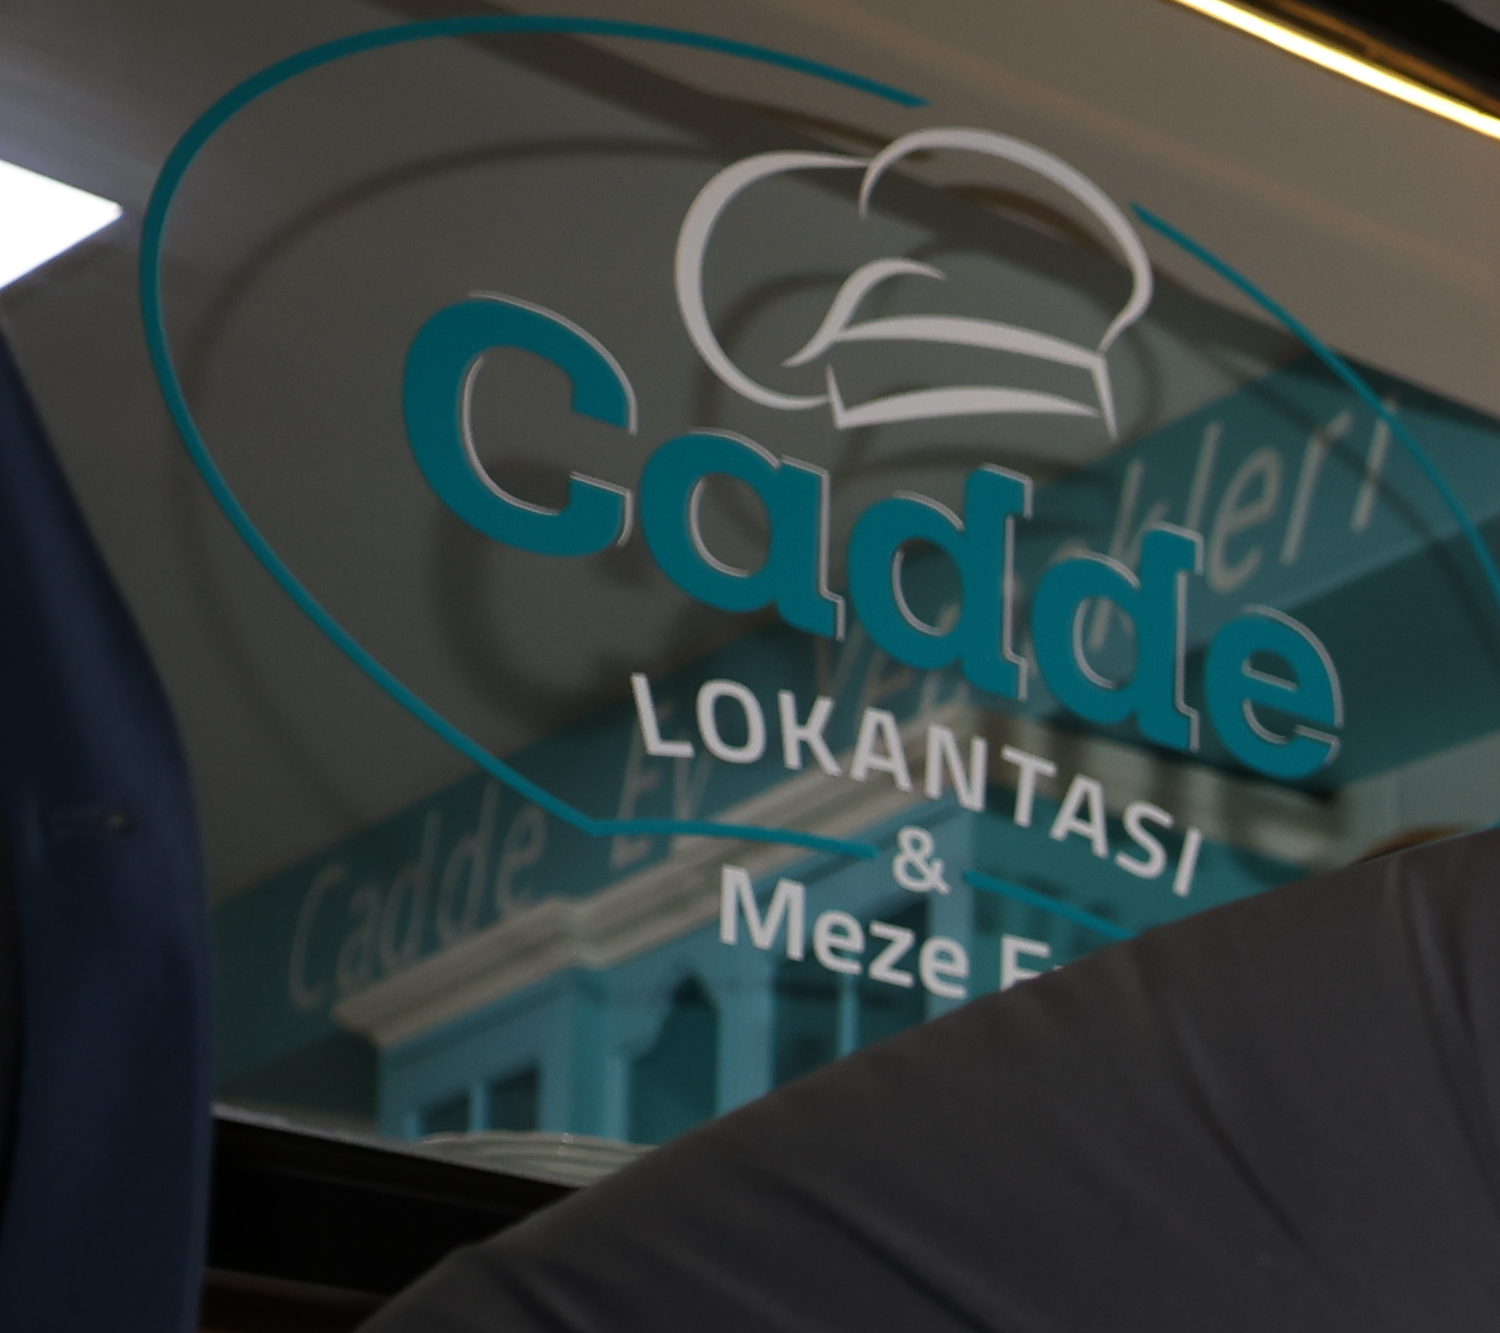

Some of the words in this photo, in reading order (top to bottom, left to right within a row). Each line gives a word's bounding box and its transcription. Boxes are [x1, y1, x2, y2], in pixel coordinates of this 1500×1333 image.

[401, 291, 1346, 779] Cadde
[631, 672, 1202, 897] LOKANTASI
[891, 826, 950, 894] &
[286, 795, 548, 1012] Cadde
[718, 865, 968, 999] Meze
